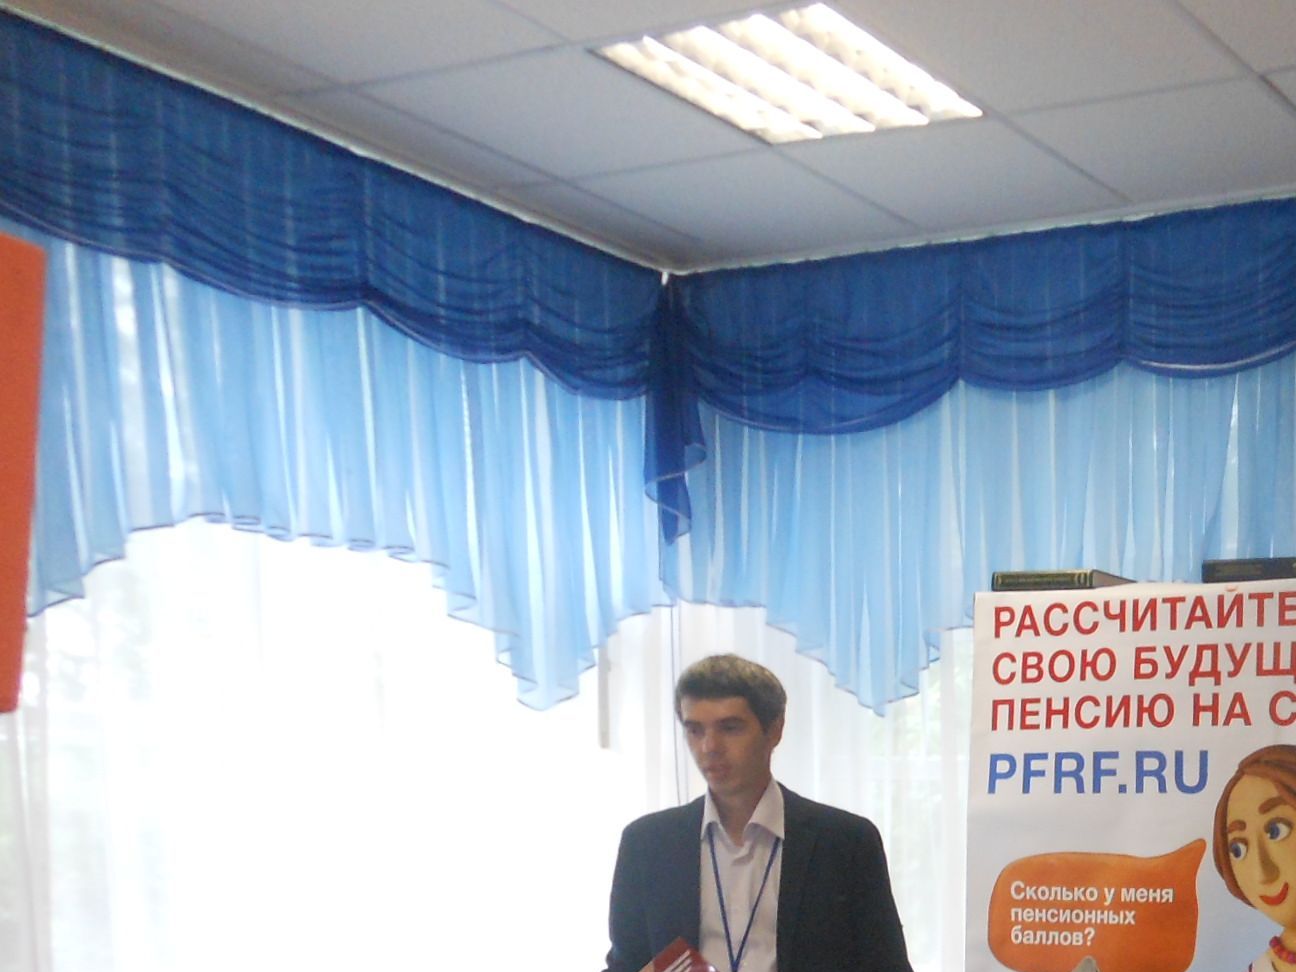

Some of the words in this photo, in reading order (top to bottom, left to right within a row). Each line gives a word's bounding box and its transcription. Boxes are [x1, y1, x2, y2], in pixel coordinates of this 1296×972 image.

[992, 645, 1118, 688] СВОЮ
[991, 693, 1176, 732] ПЕНСИЮ
[1192, 690, 1254, 728] НА
[987, 750, 1209, 795] PFRF.RU
[1010, 880, 1098, 902] Сколько
[1103, 884, 1116, 906] у
[1120, 885, 1174, 903] меня
[1010, 907, 1136, 925] пенсионных
[1010, 925, 1096, 947] баллов?
